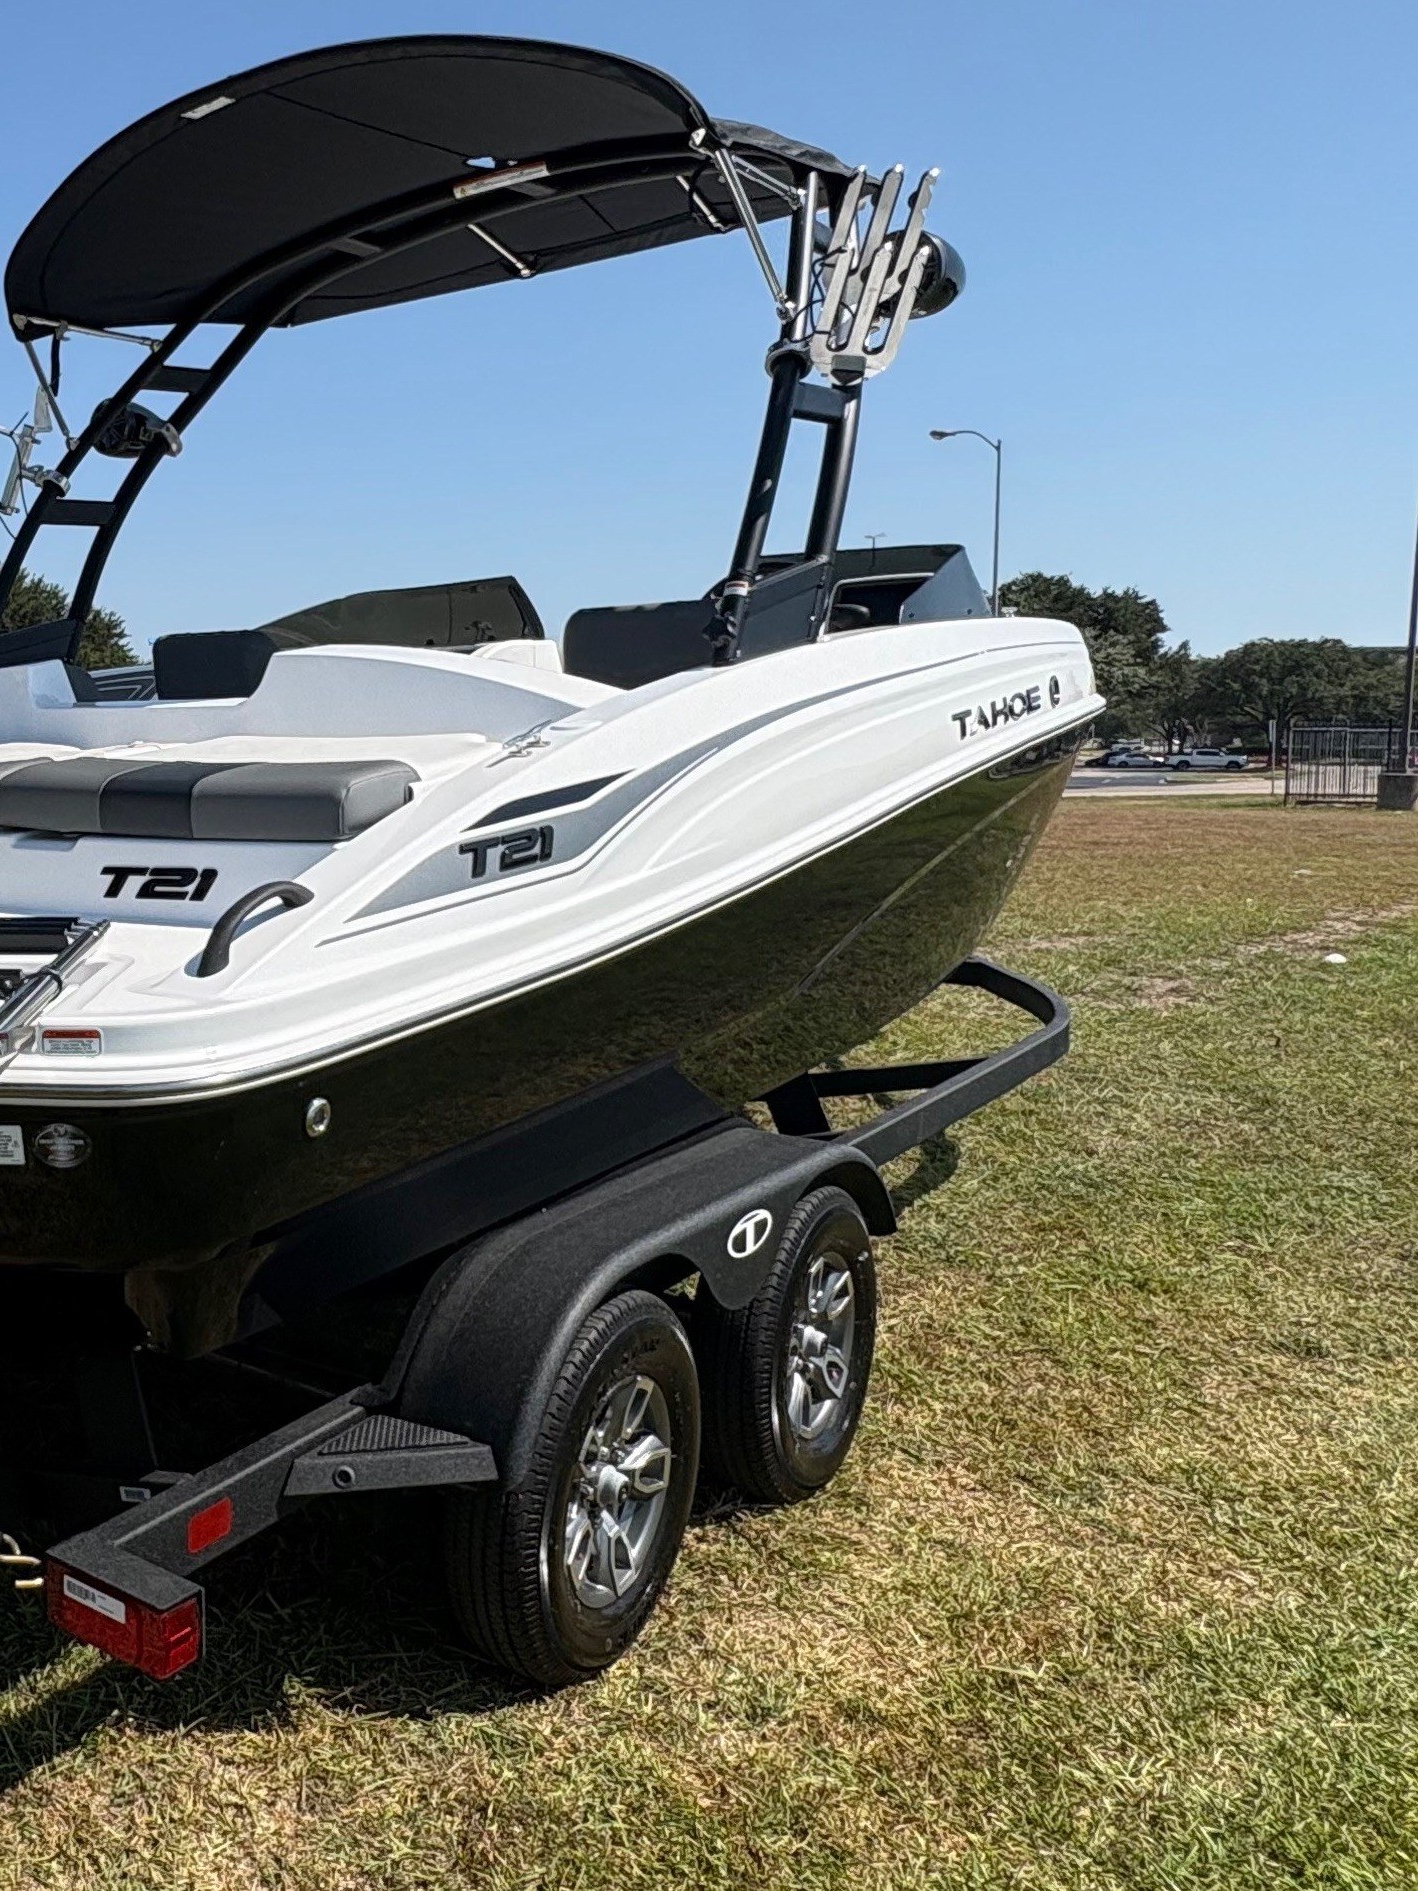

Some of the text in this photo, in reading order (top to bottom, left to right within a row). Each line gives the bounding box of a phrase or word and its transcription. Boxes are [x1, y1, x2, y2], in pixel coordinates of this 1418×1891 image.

[951, 685, 1042, 741] TAHOE
[459, 824, 555, 880] T21
[100, 866, 219, 902] T21
